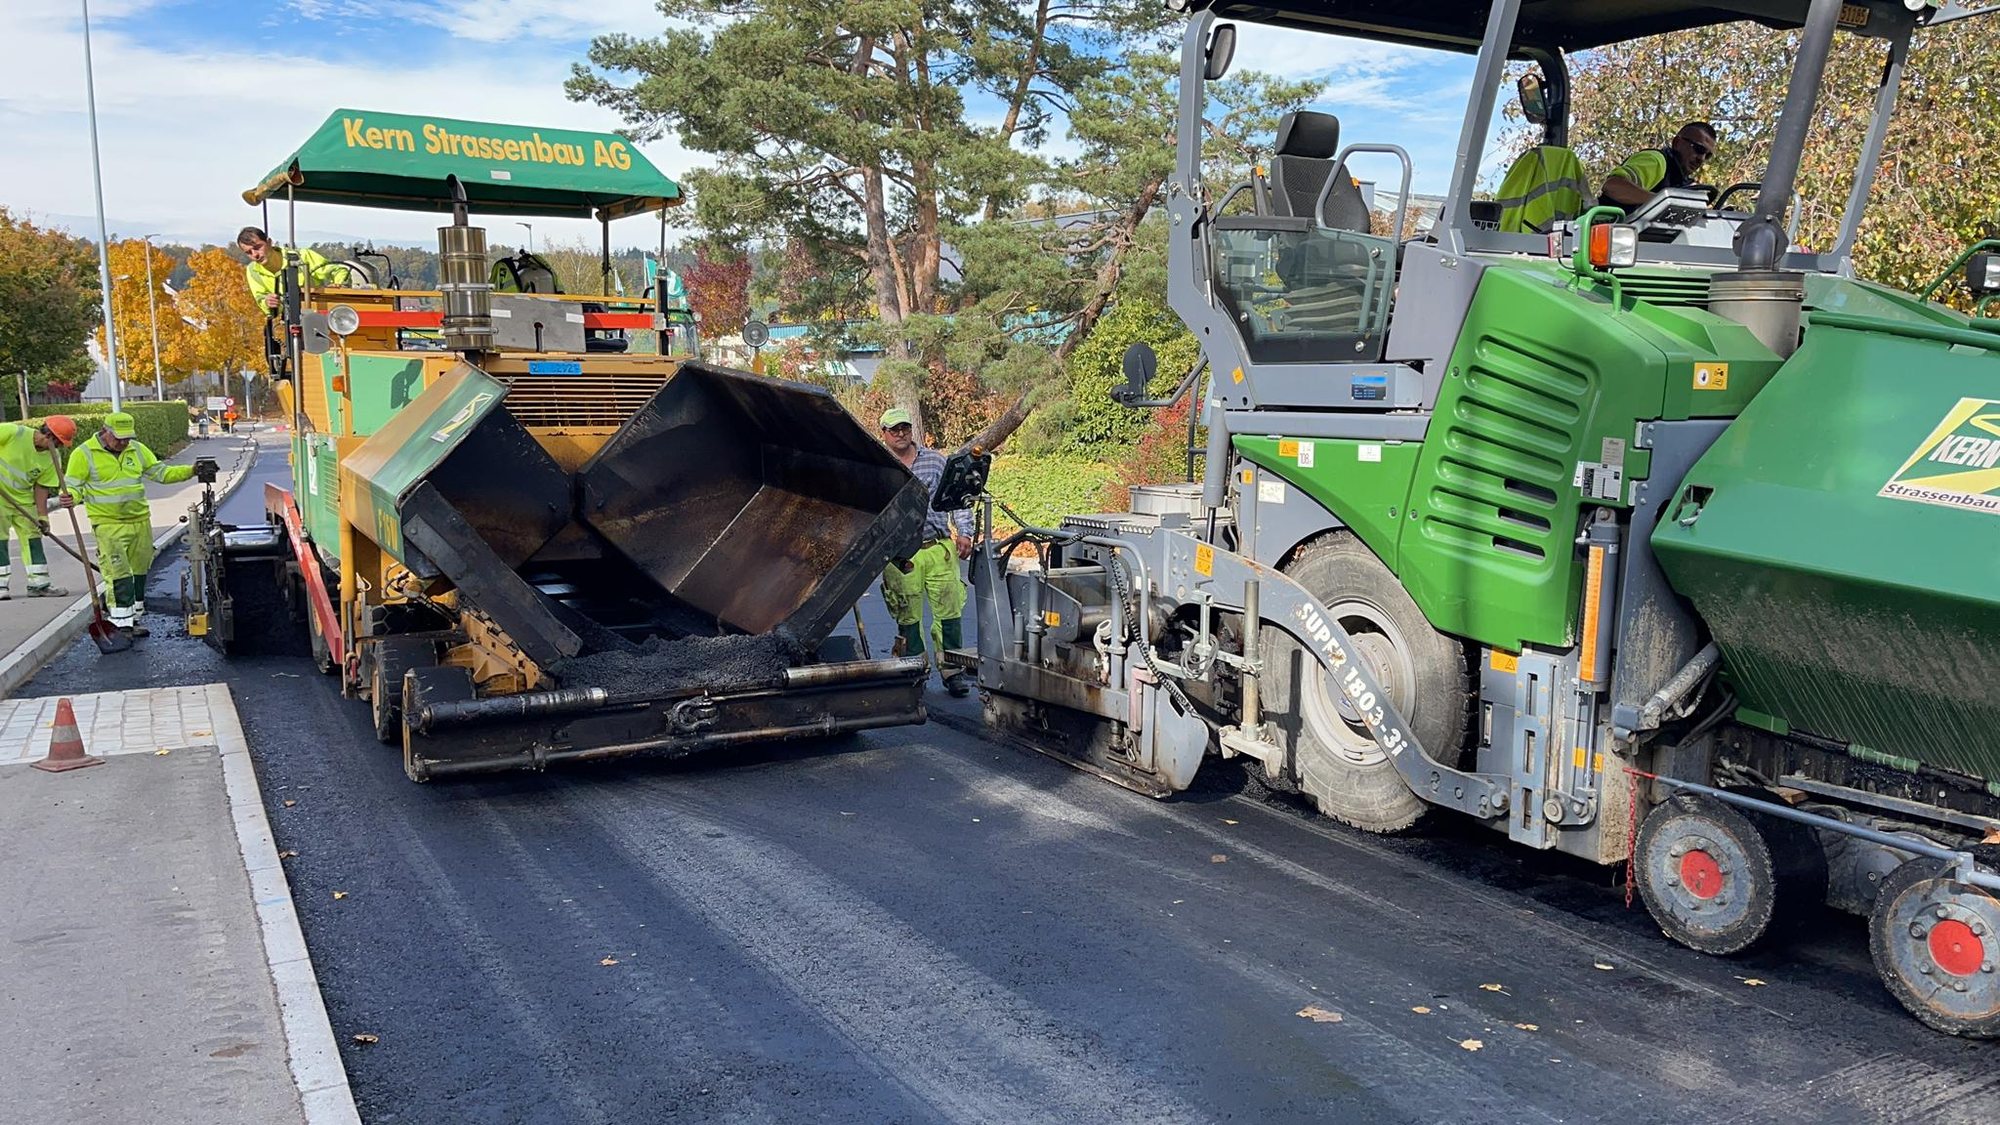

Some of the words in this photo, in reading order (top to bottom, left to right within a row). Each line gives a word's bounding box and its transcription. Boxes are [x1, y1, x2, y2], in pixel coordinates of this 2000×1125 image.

[343, 118, 415, 152] Kern
[423, 123, 585, 165] Strassenbau
[594, 140, 631, 170] AG
[1928, 434, 2000, 468] KERN
[1885, 483, 1998, 508] Strassenbau
[1296, 603, 1347, 669] SUPER
[1344, 666, 1408, 757] 1803-3i
